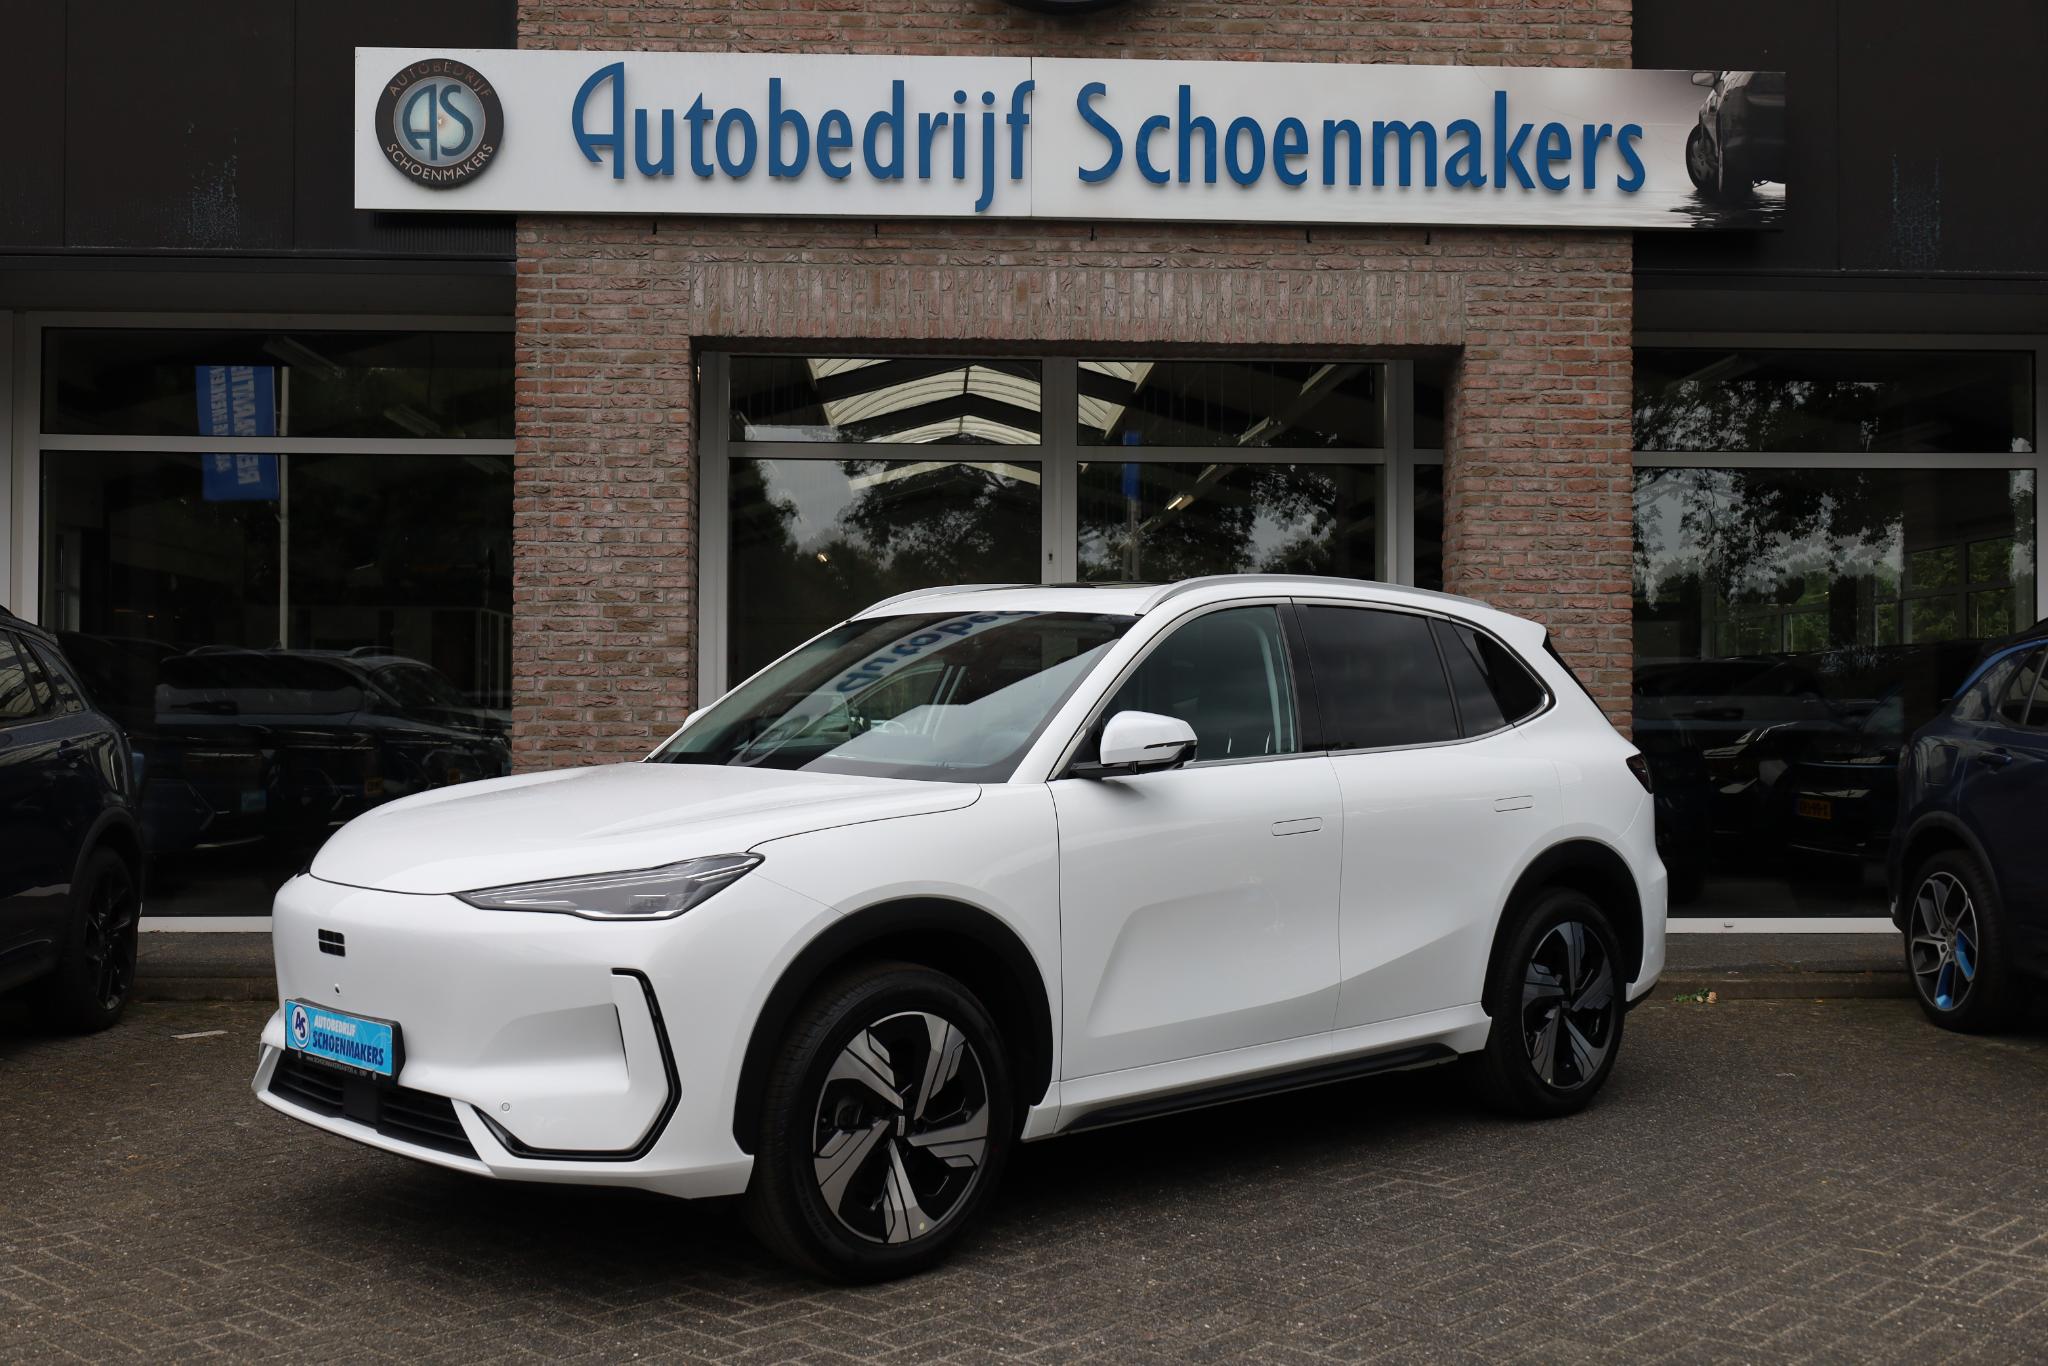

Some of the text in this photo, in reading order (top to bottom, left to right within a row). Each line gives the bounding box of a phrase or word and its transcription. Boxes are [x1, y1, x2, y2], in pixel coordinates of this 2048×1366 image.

[389, 61, 492, 96] AUTOBEDRIJF
[402, 83, 474, 161] AS
[572, 61, 1646, 213] Autobedrijf Schoenmakers
[386, 143, 493, 181] SCHOENMAKERS
[313, 1015, 356, 1037] AUTOBEDRIJF
[312, 1030, 384, 1066] SCHOENMAKERS
